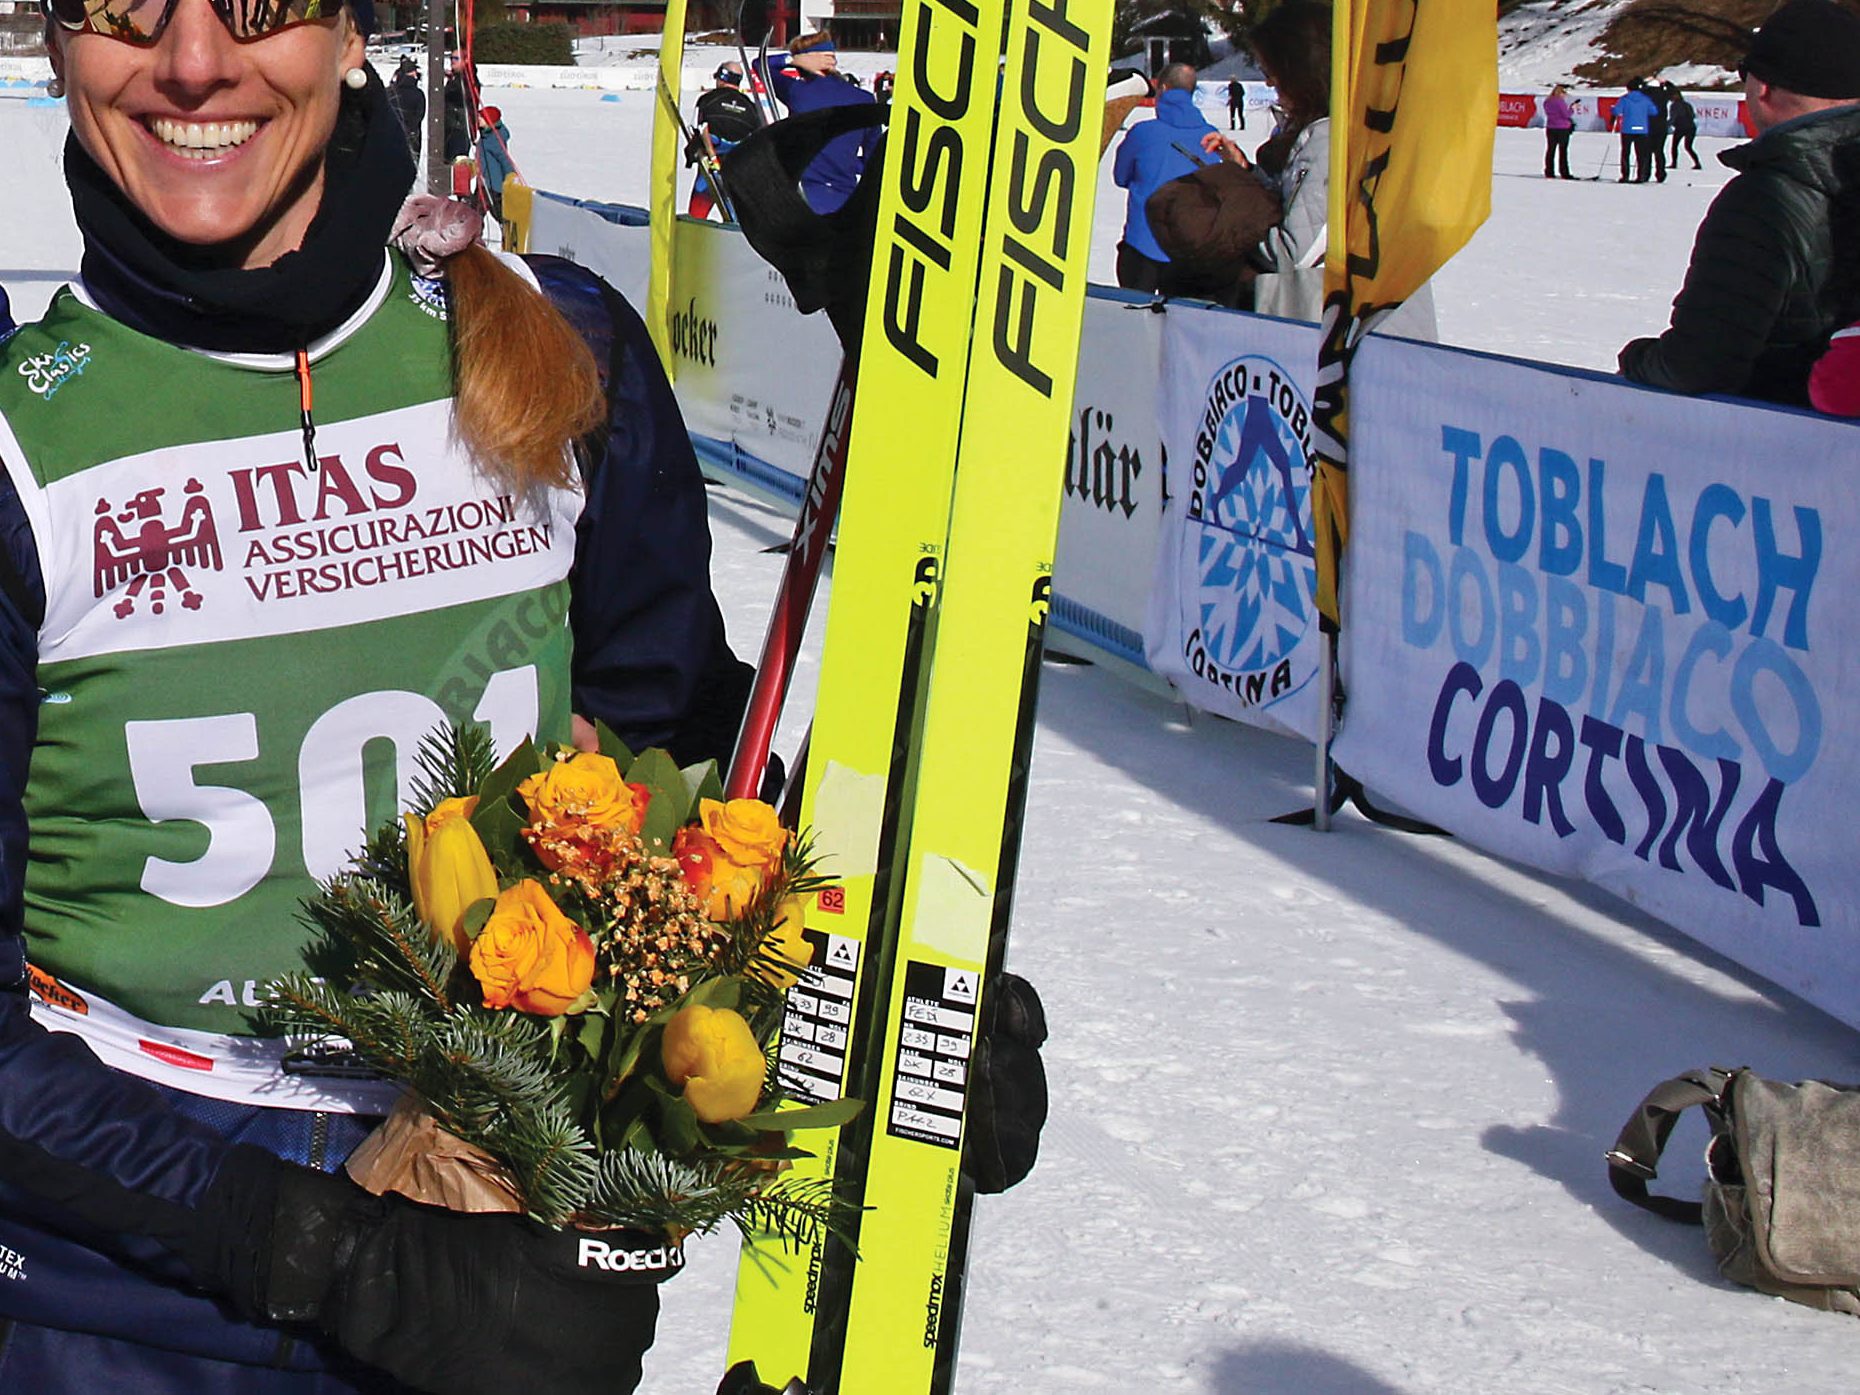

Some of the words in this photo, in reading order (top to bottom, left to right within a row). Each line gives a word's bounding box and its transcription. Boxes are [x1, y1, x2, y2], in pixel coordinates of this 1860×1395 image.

[671, 298, 719, 368] ocker
[227, 443, 418, 533] ITAS
[1188, 364, 1247, 519] DOBBIACO
[243, 494, 517, 569] ASSICURAZIONI
[244, 524, 553, 603] VERSICHERUNGEN
[1441, 424, 1823, 652] TOBLACH
[1401, 529, 1823, 787] DOBBIACO
[124, 663, 540, 908] 501
[1427, 660, 1821, 928] CORTINA
[821, 892, 844, 909] 62
[924, 1273, 943, 1350] speedmax
[935, 1205, 955, 1274] HELIUM
